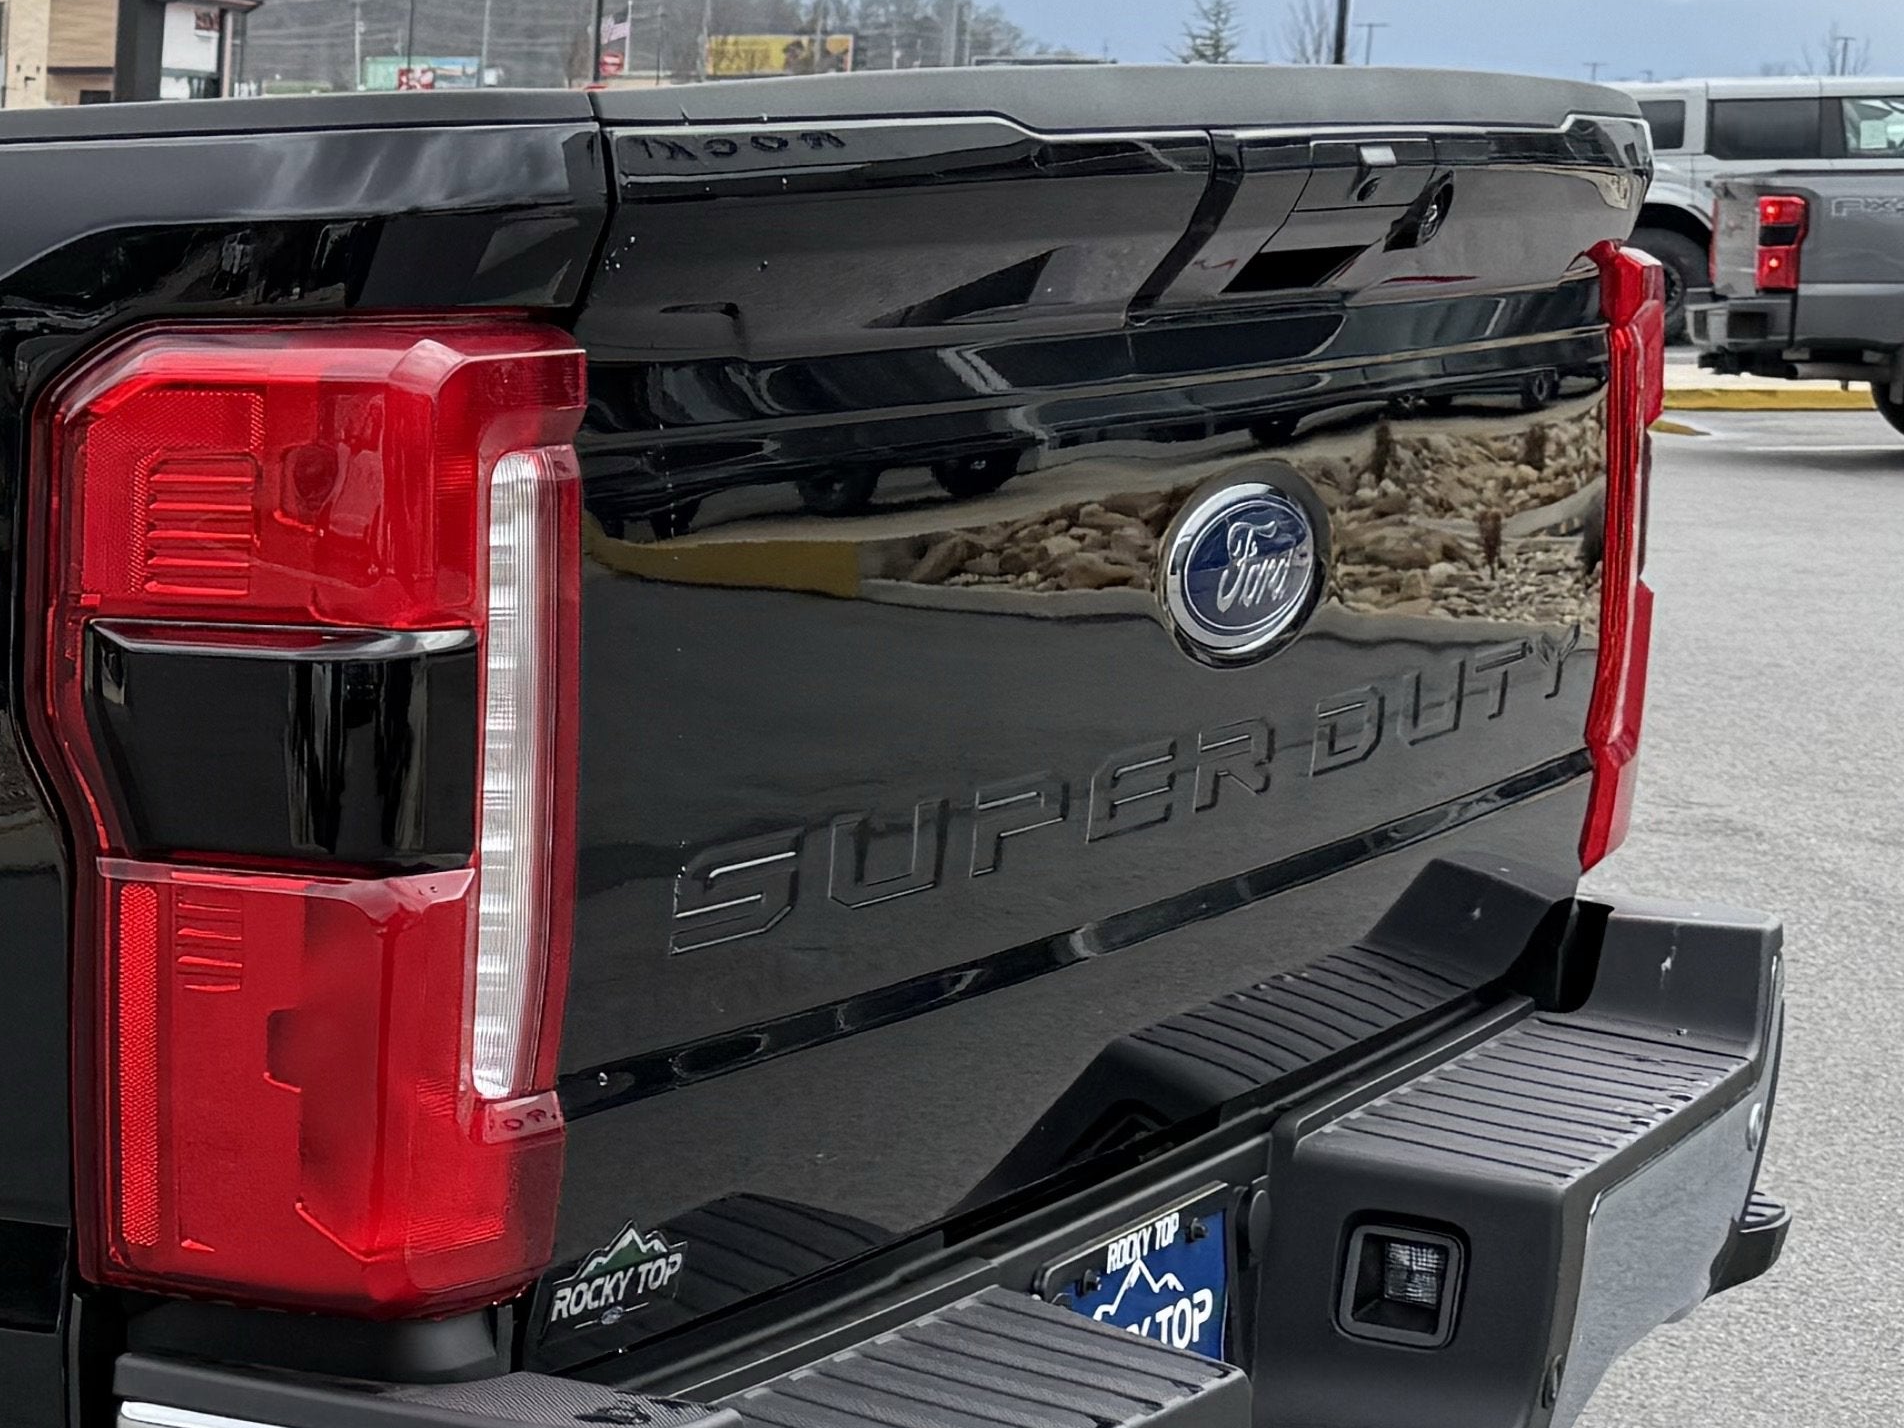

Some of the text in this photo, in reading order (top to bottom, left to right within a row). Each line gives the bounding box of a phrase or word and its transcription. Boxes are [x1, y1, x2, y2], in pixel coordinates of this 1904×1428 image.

[1216, 520, 1297, 614] Ford
[670, 622, 1583, 956] SUPER DUTY
[1106, 1211, 1180, 1275] ROCKY TOP
[550, 1253, 683, 1323] ROCKY TOP
[1155, 1288, 1213, 1350] TOP
